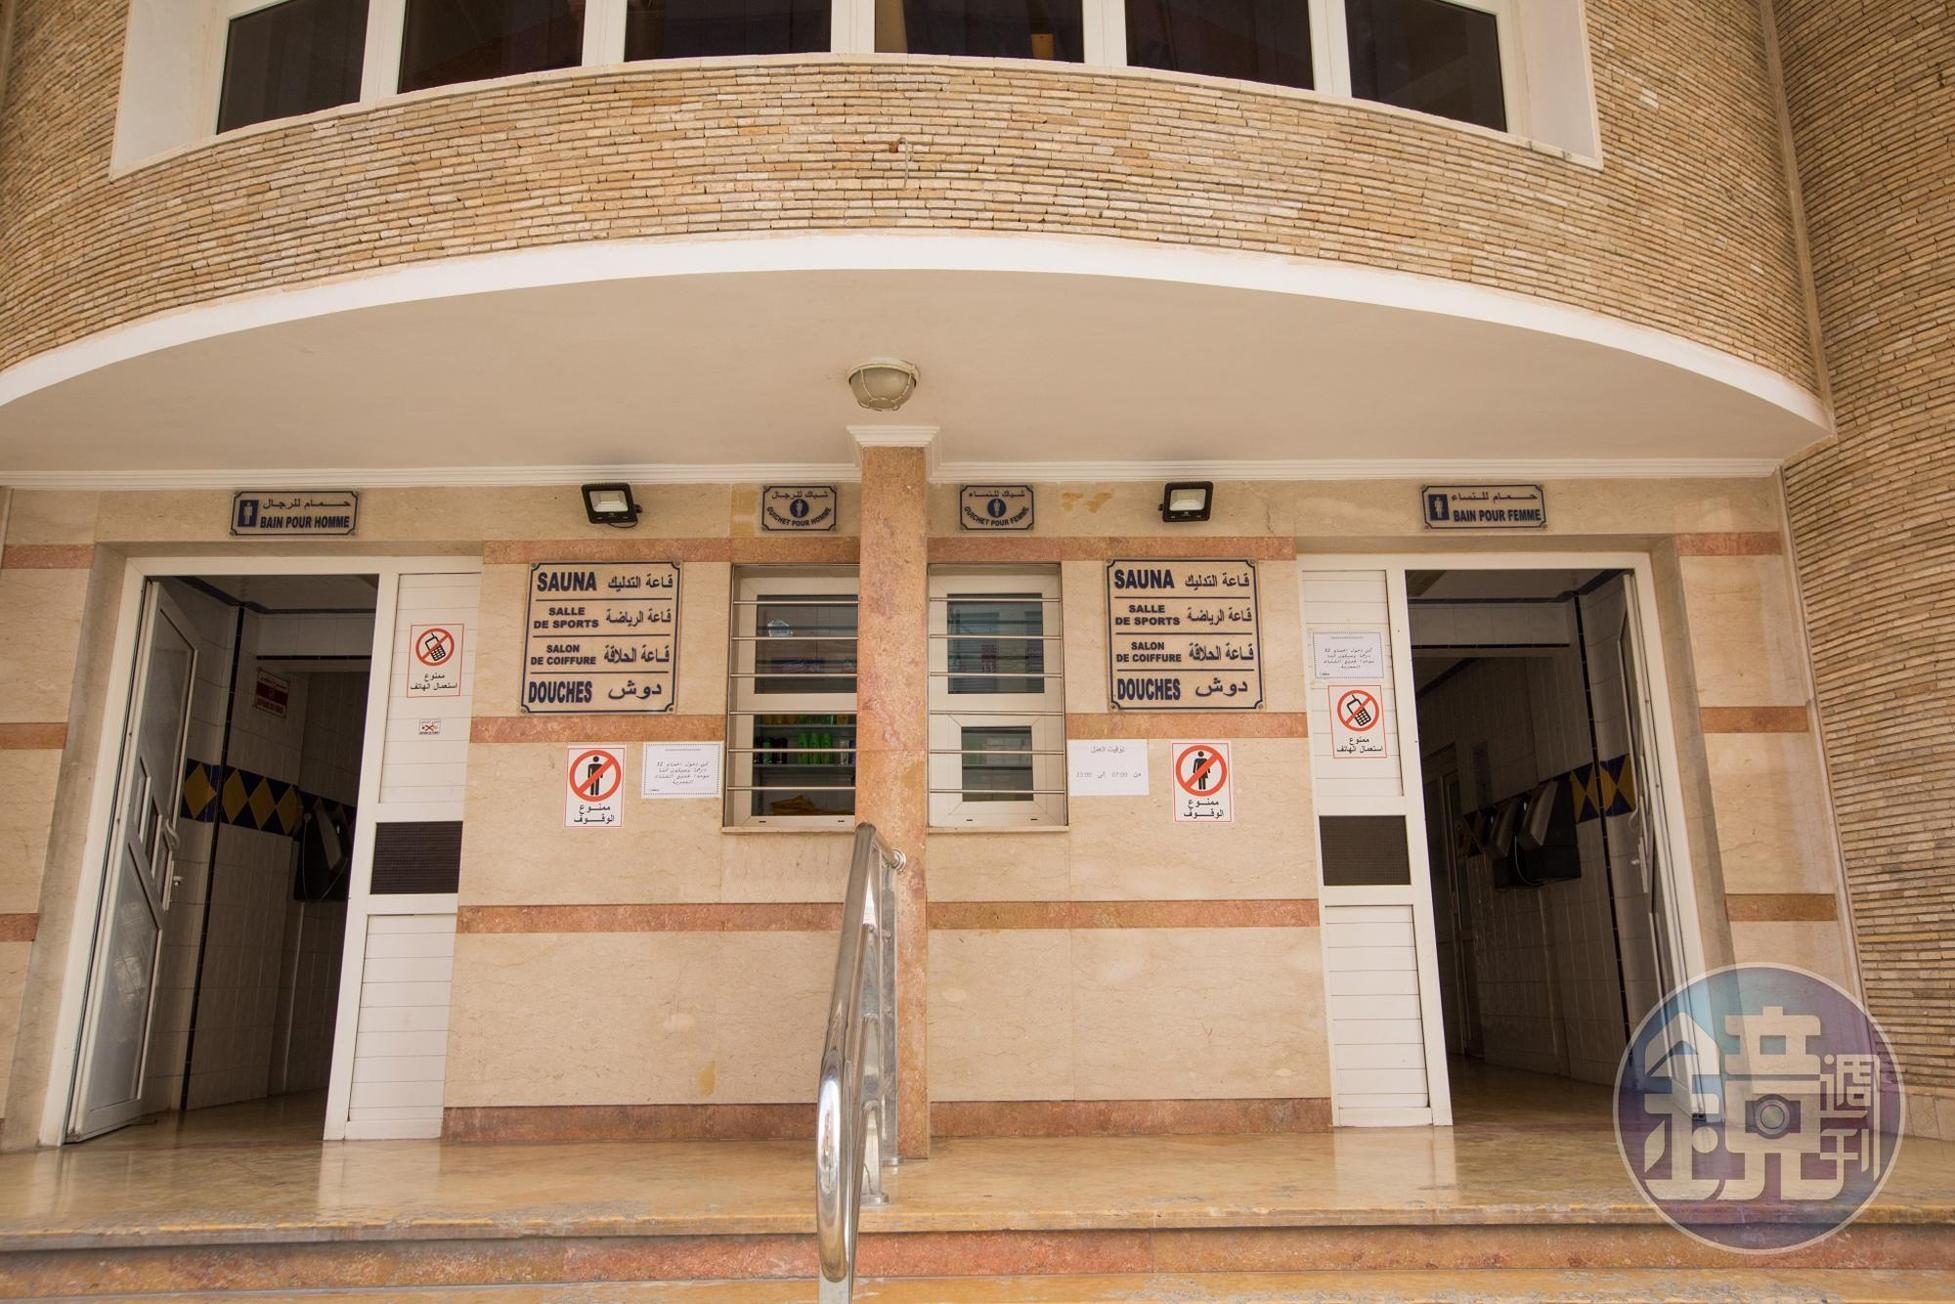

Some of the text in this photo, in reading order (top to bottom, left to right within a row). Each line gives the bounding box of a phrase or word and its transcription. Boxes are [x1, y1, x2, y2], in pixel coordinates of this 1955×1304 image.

[1453, 509, 1541, 522] BAIN POUR FEMME
[260, 516, 350, 528] BAIN POUR HOMME
[537, 572, 597, 592] SAUNA
[608, 574, 672, 592] قاعة التدليك
[1114, 569, 1174, 588] SAUNA
[1185, 572, 1249, 591] قاعة التدليك
[548, 607, 585, 616] SALLE
[1129, 605, 1165, 613] SALLE
[606, 609, 671, 627] قاعة الرياضة
[1115, 617, 1180, 625] DE SPORTS
[1187, 607, 1252, 625] قاعة الرياضة
[534, 620, 599, 629] DE SPORTS
[546, 644, 580, 653] SALON
[1131, 642, 1164, 650] SALON
[604, 645, 669, 663] قاعة الحلاقة
[1189, 643, 1254, 661] قاعة الحلاقة
[531, 656, 596, 665] DE COIFFURE
[1117, 654, 1182, 662] DE COIFFURE
[424, 673, 445, 682] ممنوع
[528, 681, 592, 703] DOUCHES
[608, 680, 662, 699] دوش
[1117, 678, 1181, 700] DOUCHES
[1195, 678, 1248, 696] دوش
[1349, 737, 1369, 746] ممنوع
[579, 803, 610, 814] ممنوع
[1188, 798, 1219, 809] ممنوع
[573, 814, 615, 824] الوقوف
[1184, 808, 1224, 819] الوقوف
